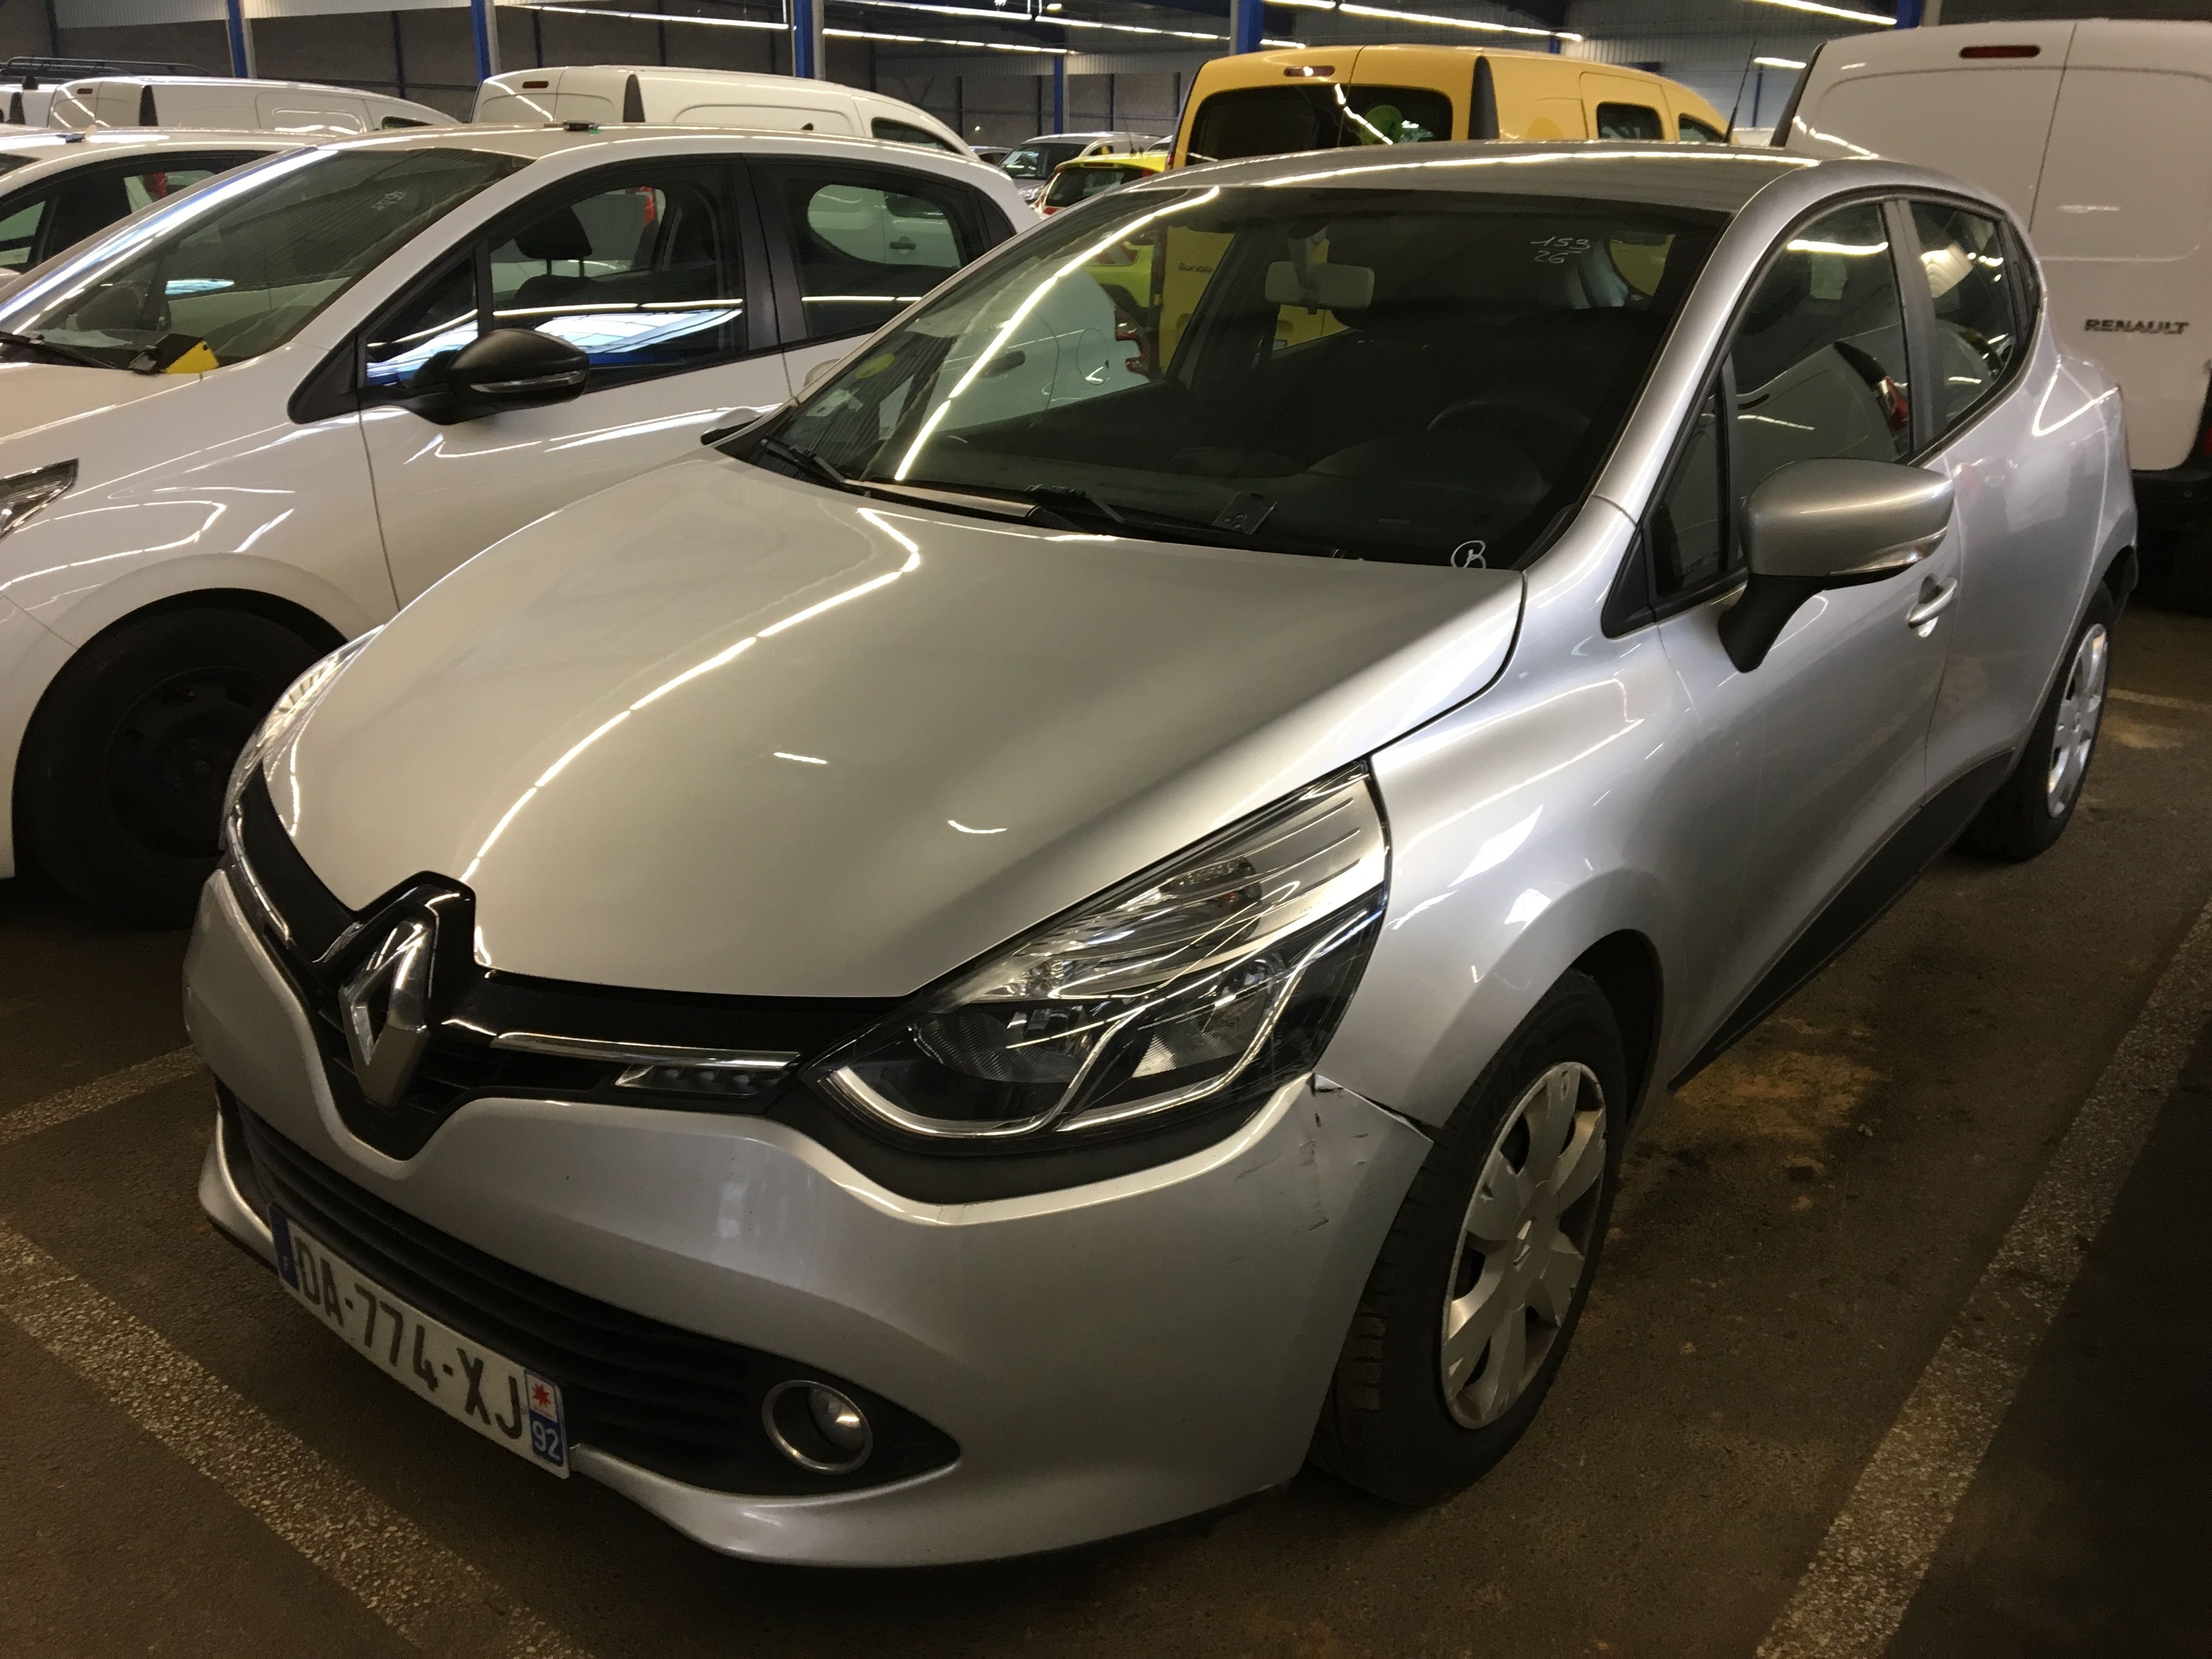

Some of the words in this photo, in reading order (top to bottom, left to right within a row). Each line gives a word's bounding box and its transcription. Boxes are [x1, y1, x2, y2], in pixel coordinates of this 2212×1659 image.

[2084, 318, 2190, 335] RENAULT
[295, 1236, 522, 1440] DA-774-XJ
[532, 1420, 561, 1460] 92
